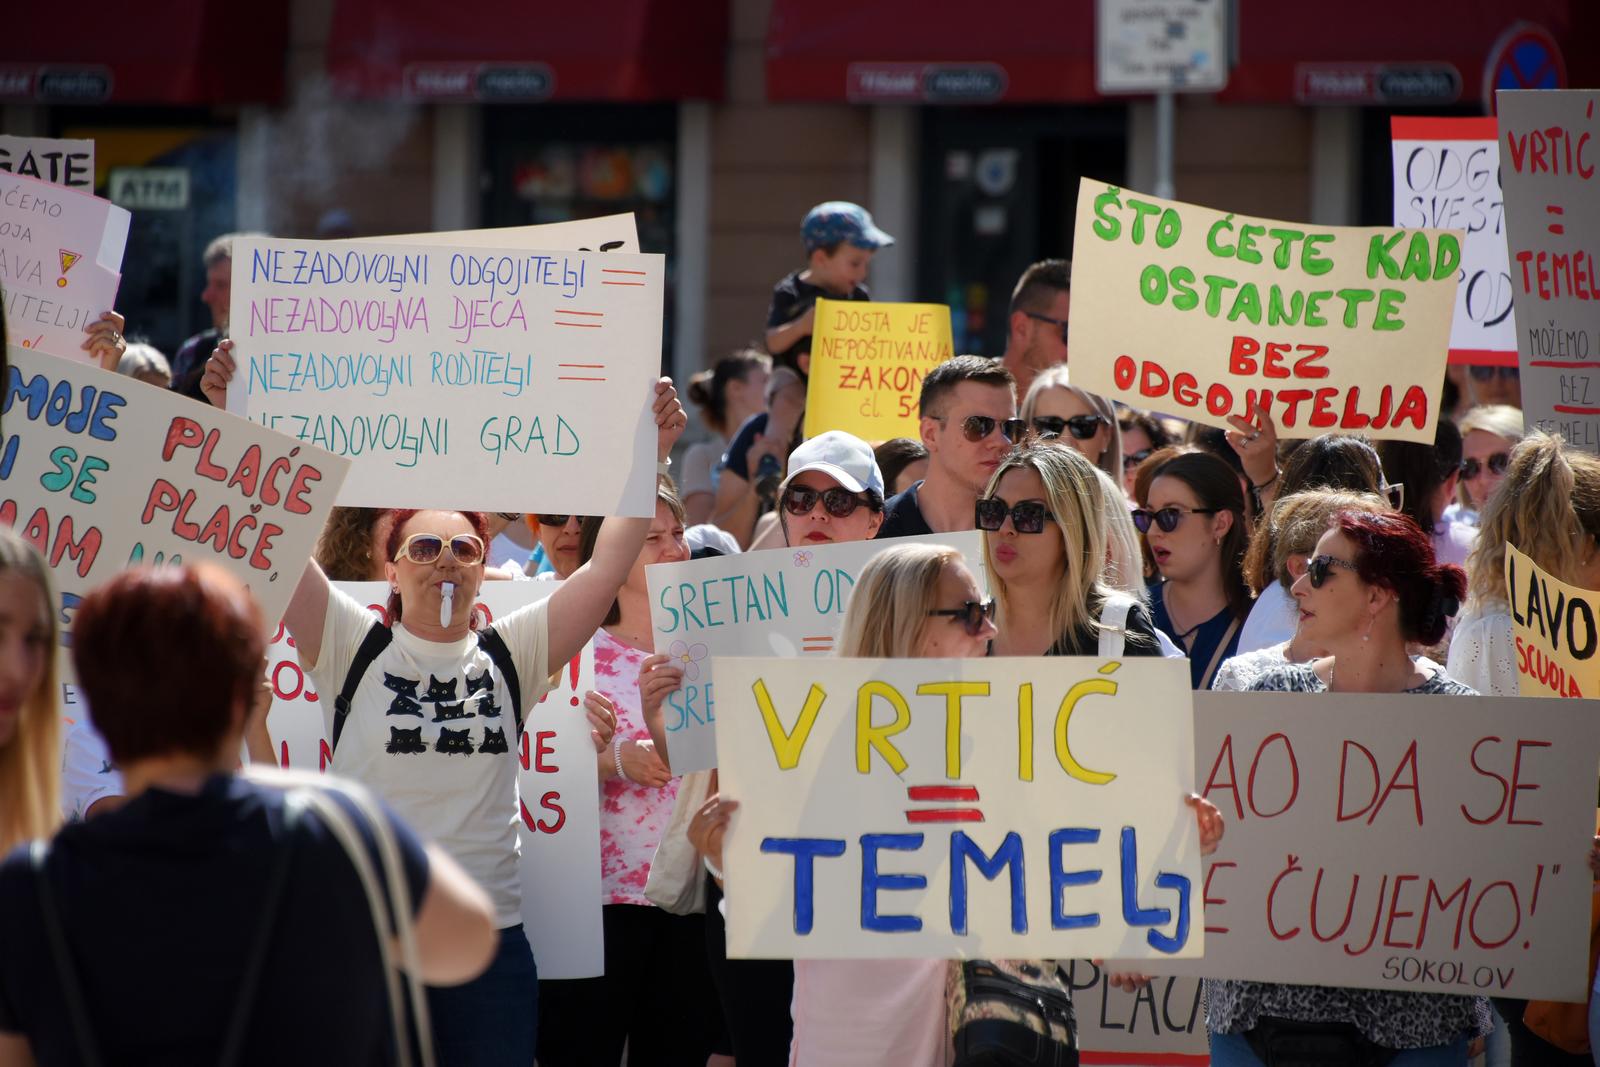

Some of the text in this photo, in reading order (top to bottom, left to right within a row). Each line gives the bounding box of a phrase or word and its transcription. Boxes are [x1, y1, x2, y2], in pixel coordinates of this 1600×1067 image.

[1508, 99, 1595, 180] VRTIĆ
[0, 185, 62, 218] ĆEMO
[1093, 186, 1461, 282] ŠTO ĆETE KAD
[251, 249, 428, 292] NEZADOVOLJNI
[450, 254, 585, 302] ODGOJITELJI
[1140, 264, 1406, 331] OSTANETE
[1459, 270, 1514, 328] OD
[250, 297, 428, 343] NEZADOVOLJNA
[448, 296, 527, 343] DJECA
[833, 310, 932, 334] DOSTA JE
[1529, 319, 1589, 359] MOŽEMO
[248, 352, 412, 396] NEZADOVOLJNI
[821, 336, 950, 362] NEPOŠTIVANJA
[1229, 336, 1329, 379] BEZ
[1113, 355, 1428, 430] ODGOJITELJA
[1560, 374, 1593, 404] BEZ
[162, 417, 322, 515] PLAĆE
[480, 415, 579, 464] GRAD
[40, 446, 109, 504] SE
[657, 571, 789, 633] SRETAN
[1509, 554, 1598, 660] LAVO
[1515, 636, 1583, 698] SCUOLA
[751, 661, 1122, 785] VRTIĆ
[1337, 739, 1423, 826] DA
[1461, 736, 1552, 826] SE
[760, 826, 1191, 954] TEMELJ
[1382, 956, 1514, 989] SOKOLOV
